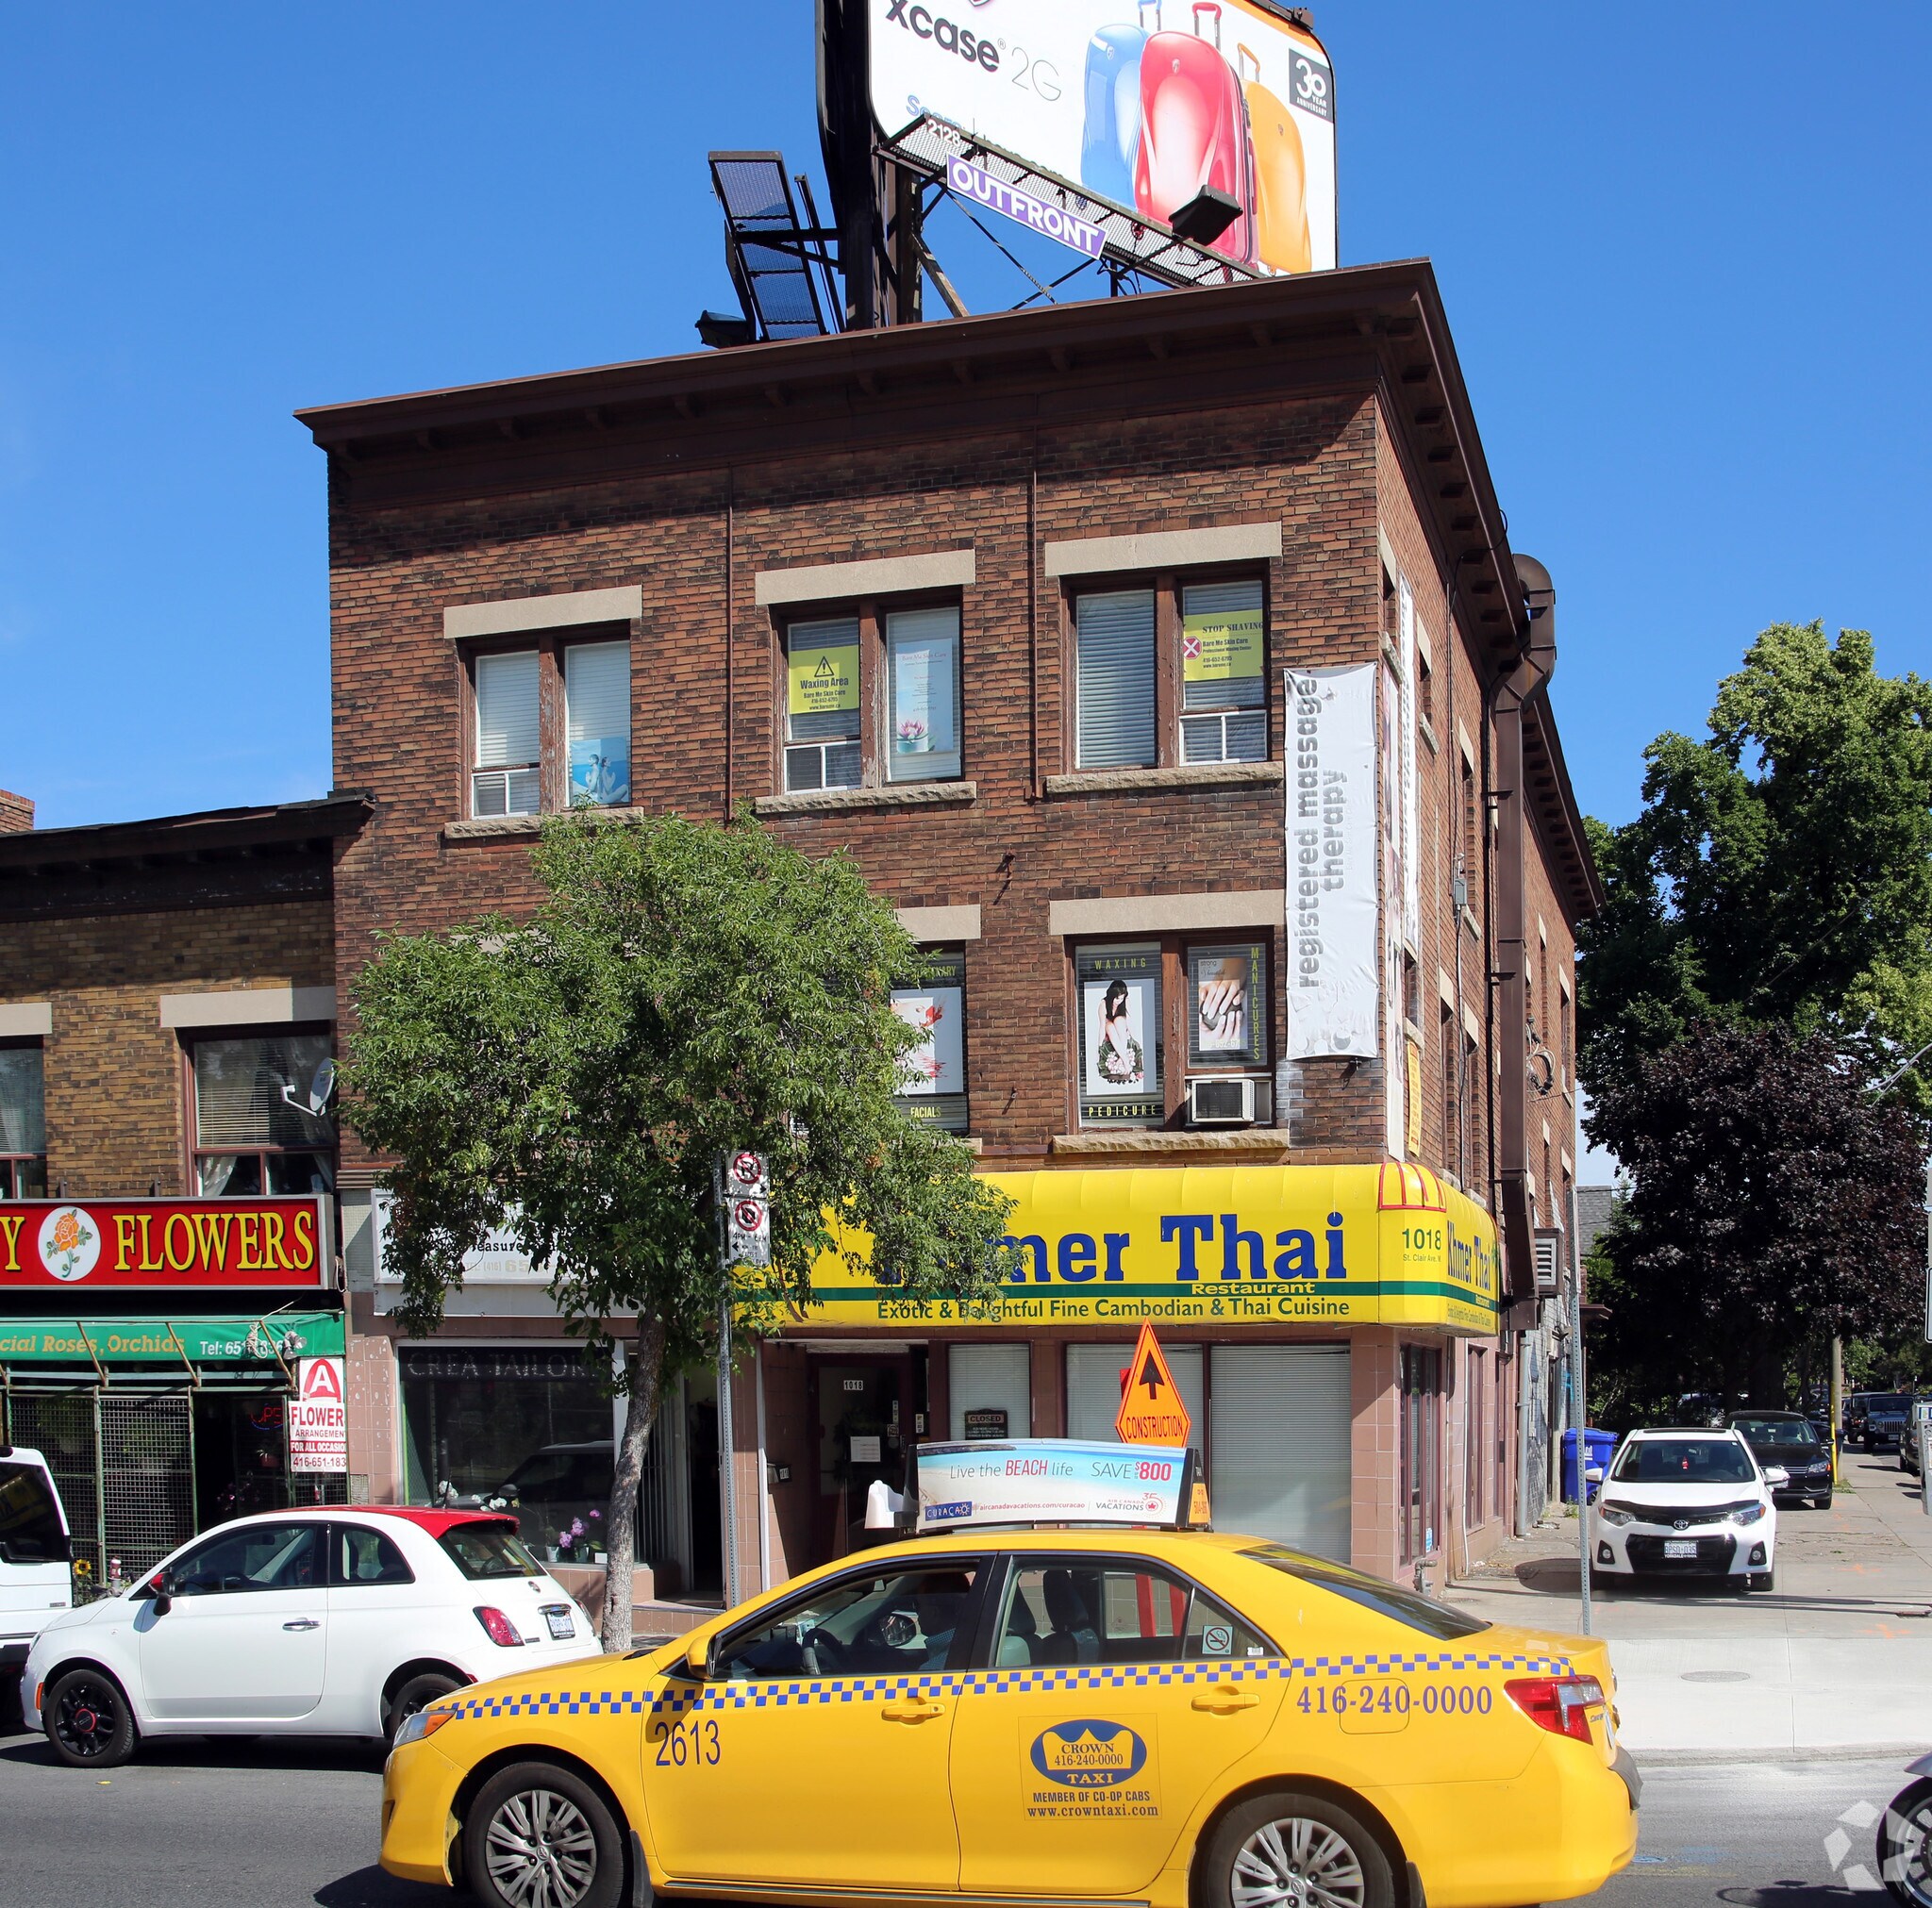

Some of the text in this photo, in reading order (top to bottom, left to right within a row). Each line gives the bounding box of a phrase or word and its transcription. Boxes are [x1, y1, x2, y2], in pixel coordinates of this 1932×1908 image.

[1011, 47, 1061, 101] 2G
[1296, 58, 1326, 99] 30
[1297, 97, 1327, 117] ANNIVERSARY
[1312, 95, 1327, 108] YEAR
[927, 119, 961, 146] 2128
[952, 161, 1100, 254] OUTFRONT
[1227, 622, 1263, 631] SHAVING
[800, 677, 849, 689] Waxing Area
[1293, 678, 1324, 988] registered massage
[1321, 769, 1347, 892] therapy
[1094, 958, 1146, 970] WAXING
[1251, 947, 1259, 1060] MANICURES
[910, 1106, 941, 1118] FACIALS
[1089, 1105, 1156, 1117] PEDICURE
[112, 1210, 315, 1271] FLOWERS
[1160, 1211, 1347, 1281] Thai
[1402, 1228, 1441, 1250] 1018
[472, 1241, 523, 1253] easure
[1447, 1219, 1491, 1291] Khmer Thai
[1191, 1282, 1316, 1295] Restaurant
[877, 1302, 933, 1319] Exotic
[940, 1302, 953, 1319] &
[1050, 1300, 1089, 1317] Fine
[1094, 1297, 1202, 1318] Cambodian
[1210, 1300, 1224, 1316] &
[1228, 1297, 1272, 1316] Thai
[1278, 1297, 1350, 1316] Cuisine
[108, 1335, 186, 1352] Orchids
[200, 1341, 223, 1355] Tel:
[844, 1381, 862, 1389] 1018
[291, 1406, 344, 1427] FLOWER
[295, 1429, 346, 1437] ARRANGEMEN
[1126, 1416, 1184, 1438] CONSTRUCTION
[291, 1441, 304, 1452] FOR
[305, 1441, 316, 1452] ALL
[950, 1465, 974, 1479] Live
[979, 1463, 1001, 1477] the
[1006, 1459, 1048, 1476] BEACH
[1052, 1462, 1074, 1476] life
[1091, 1462, 1132, 1479] SAVE
[1135, 1461, 1172, 1481] $800
[979, 1502, 1085, 1511] aircanadavacations.com/curacao
[1096, 1502, 1143, 1511] VACATIONS
[1296, 1685, 1492, 1715] 416-240-0000
[655, 1719, 722, 1766] 2613
[1061, 1743, 1114, 1754] CROWN
[1055, 1754, 1124, 1766] 416-240-0000
[1067, 1773, 1113, 1784] TAXI
[1033, 1791, 1150, 1802] MEMBER OF CO-OP CABS
[1027, 1803, 1158, 1817] www.crowntaxi.com
